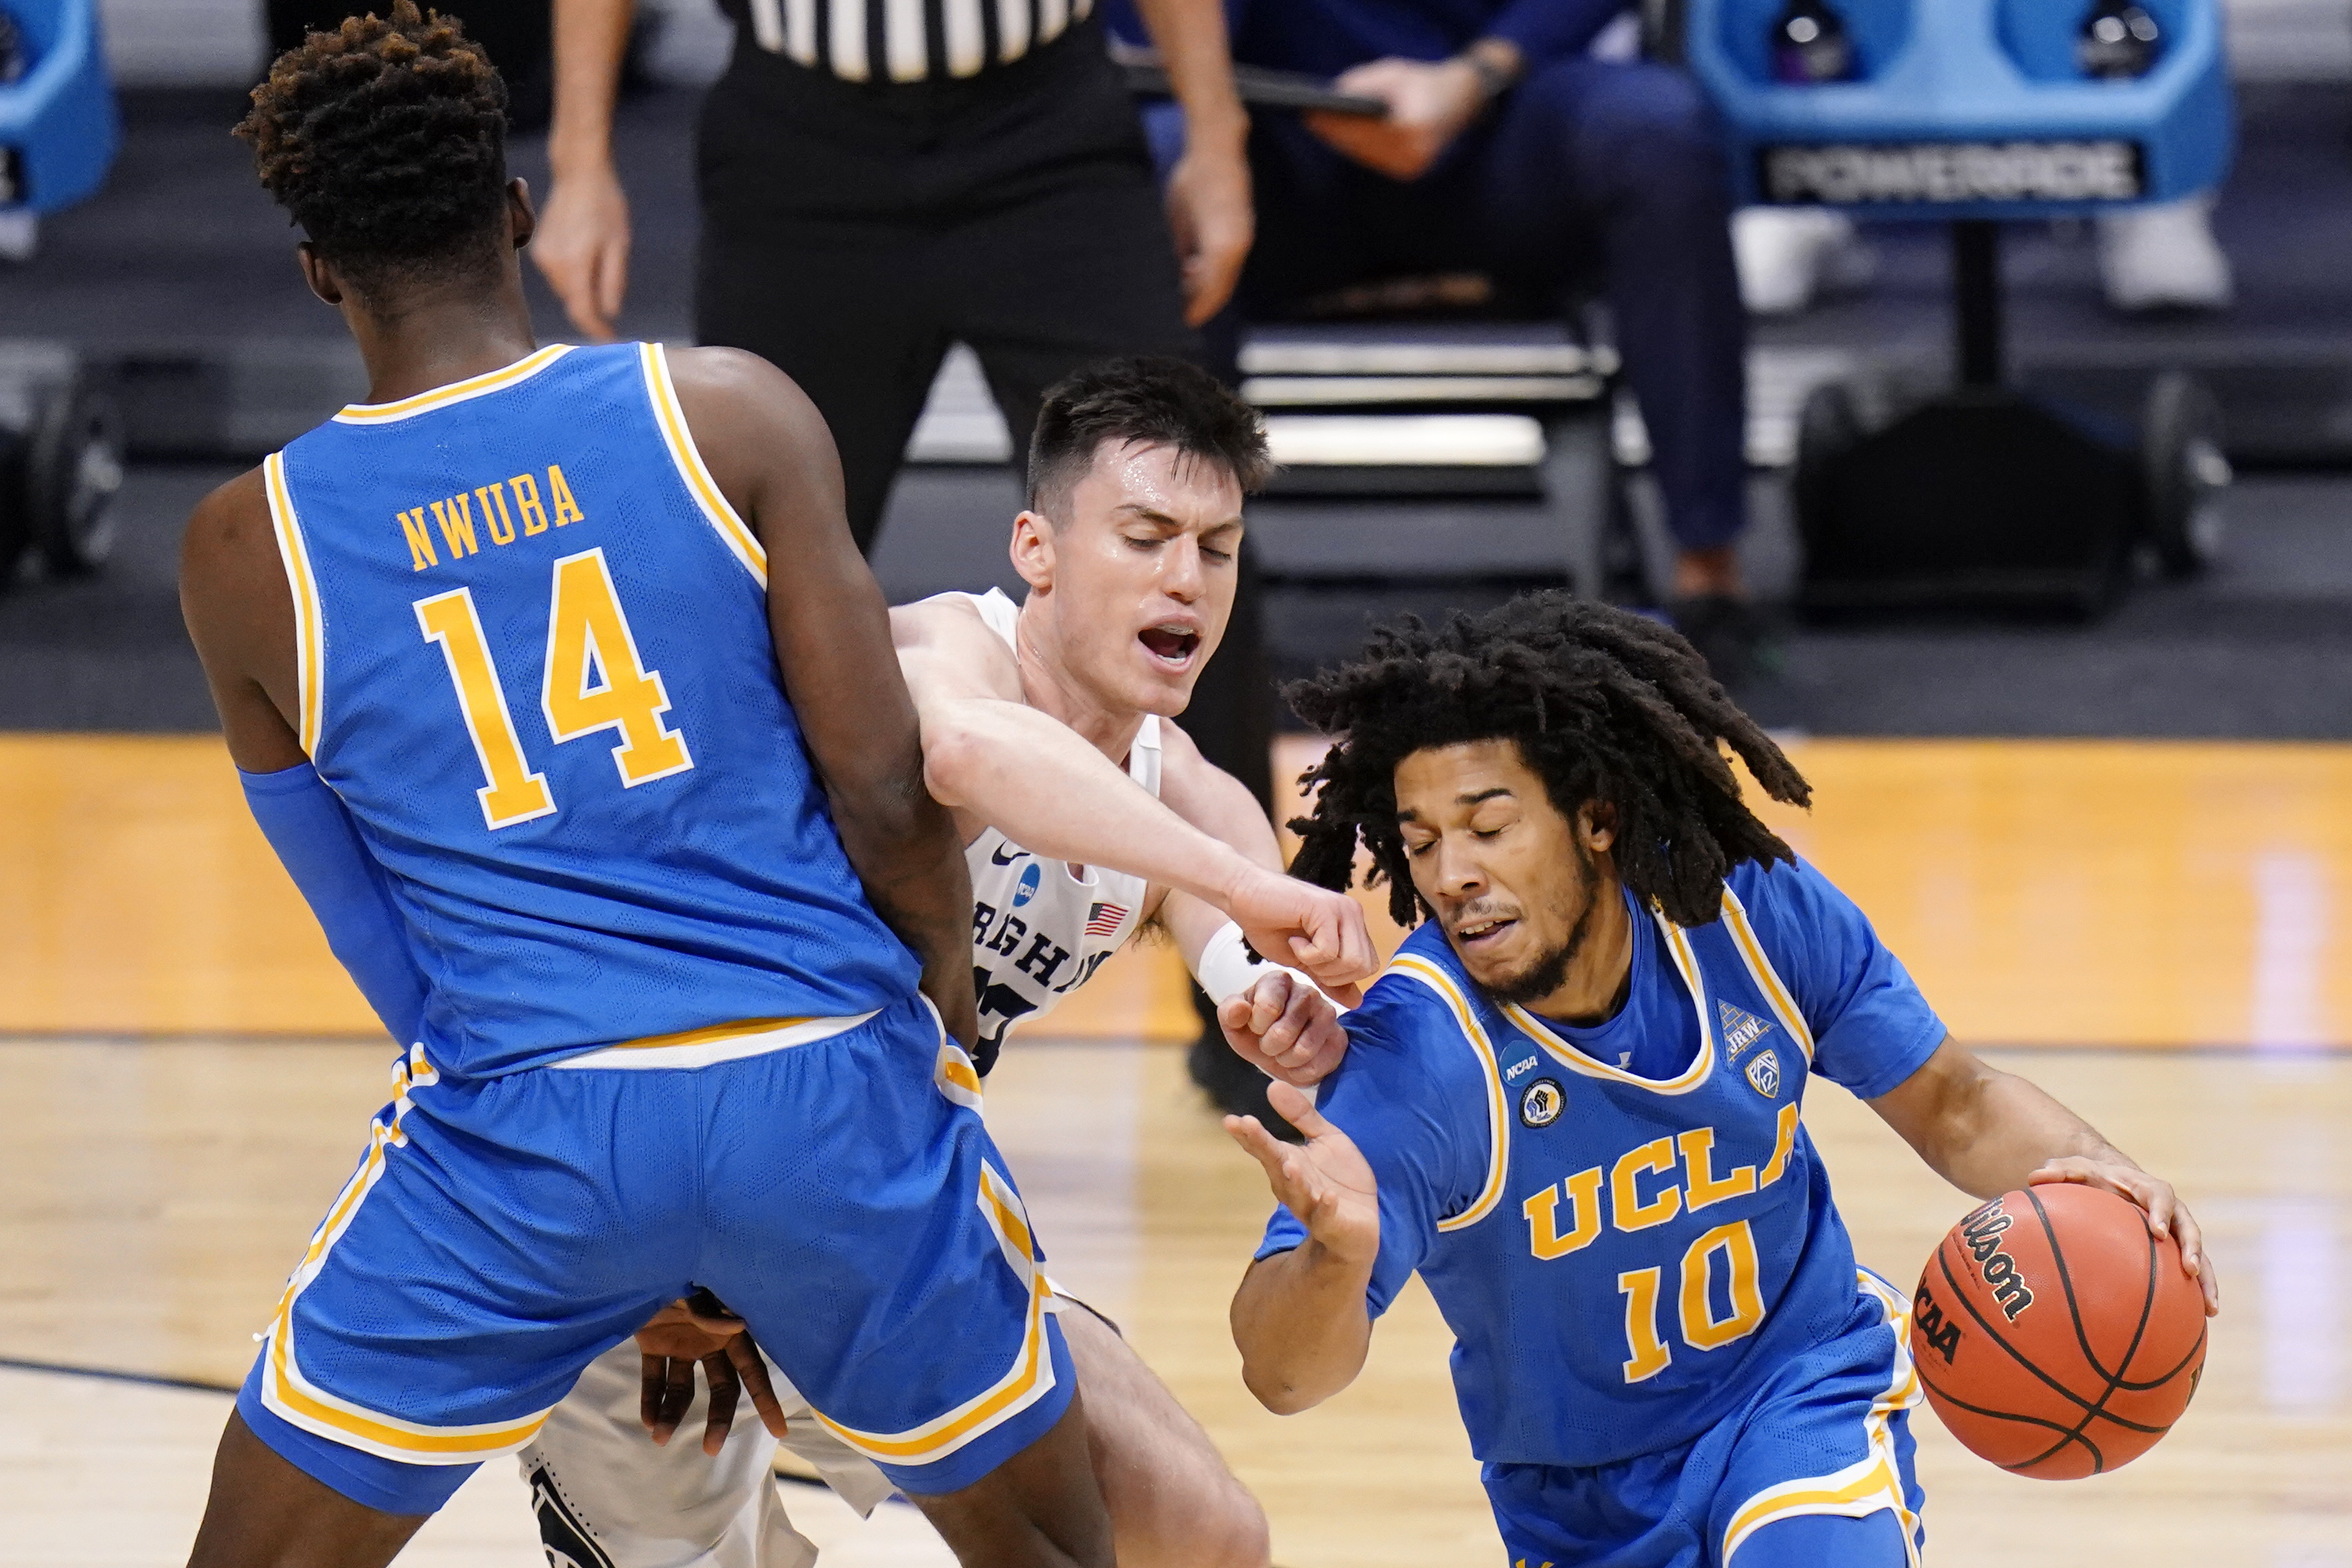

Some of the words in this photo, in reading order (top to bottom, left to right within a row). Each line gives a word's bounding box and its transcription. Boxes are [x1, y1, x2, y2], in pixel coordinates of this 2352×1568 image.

[397, 465, 584, 571] NWUBA
[412, 547, 694, 831] 14
[1506, 1055, 1539, 1081] NCAA
[1729, 1018, 1760, 1054] JRW
[1523, 1101, 1799, 1261] UCLA
[1618, 1219, 1766, 1384] 10
[1913, 1275, 1962, 1366] CAA
